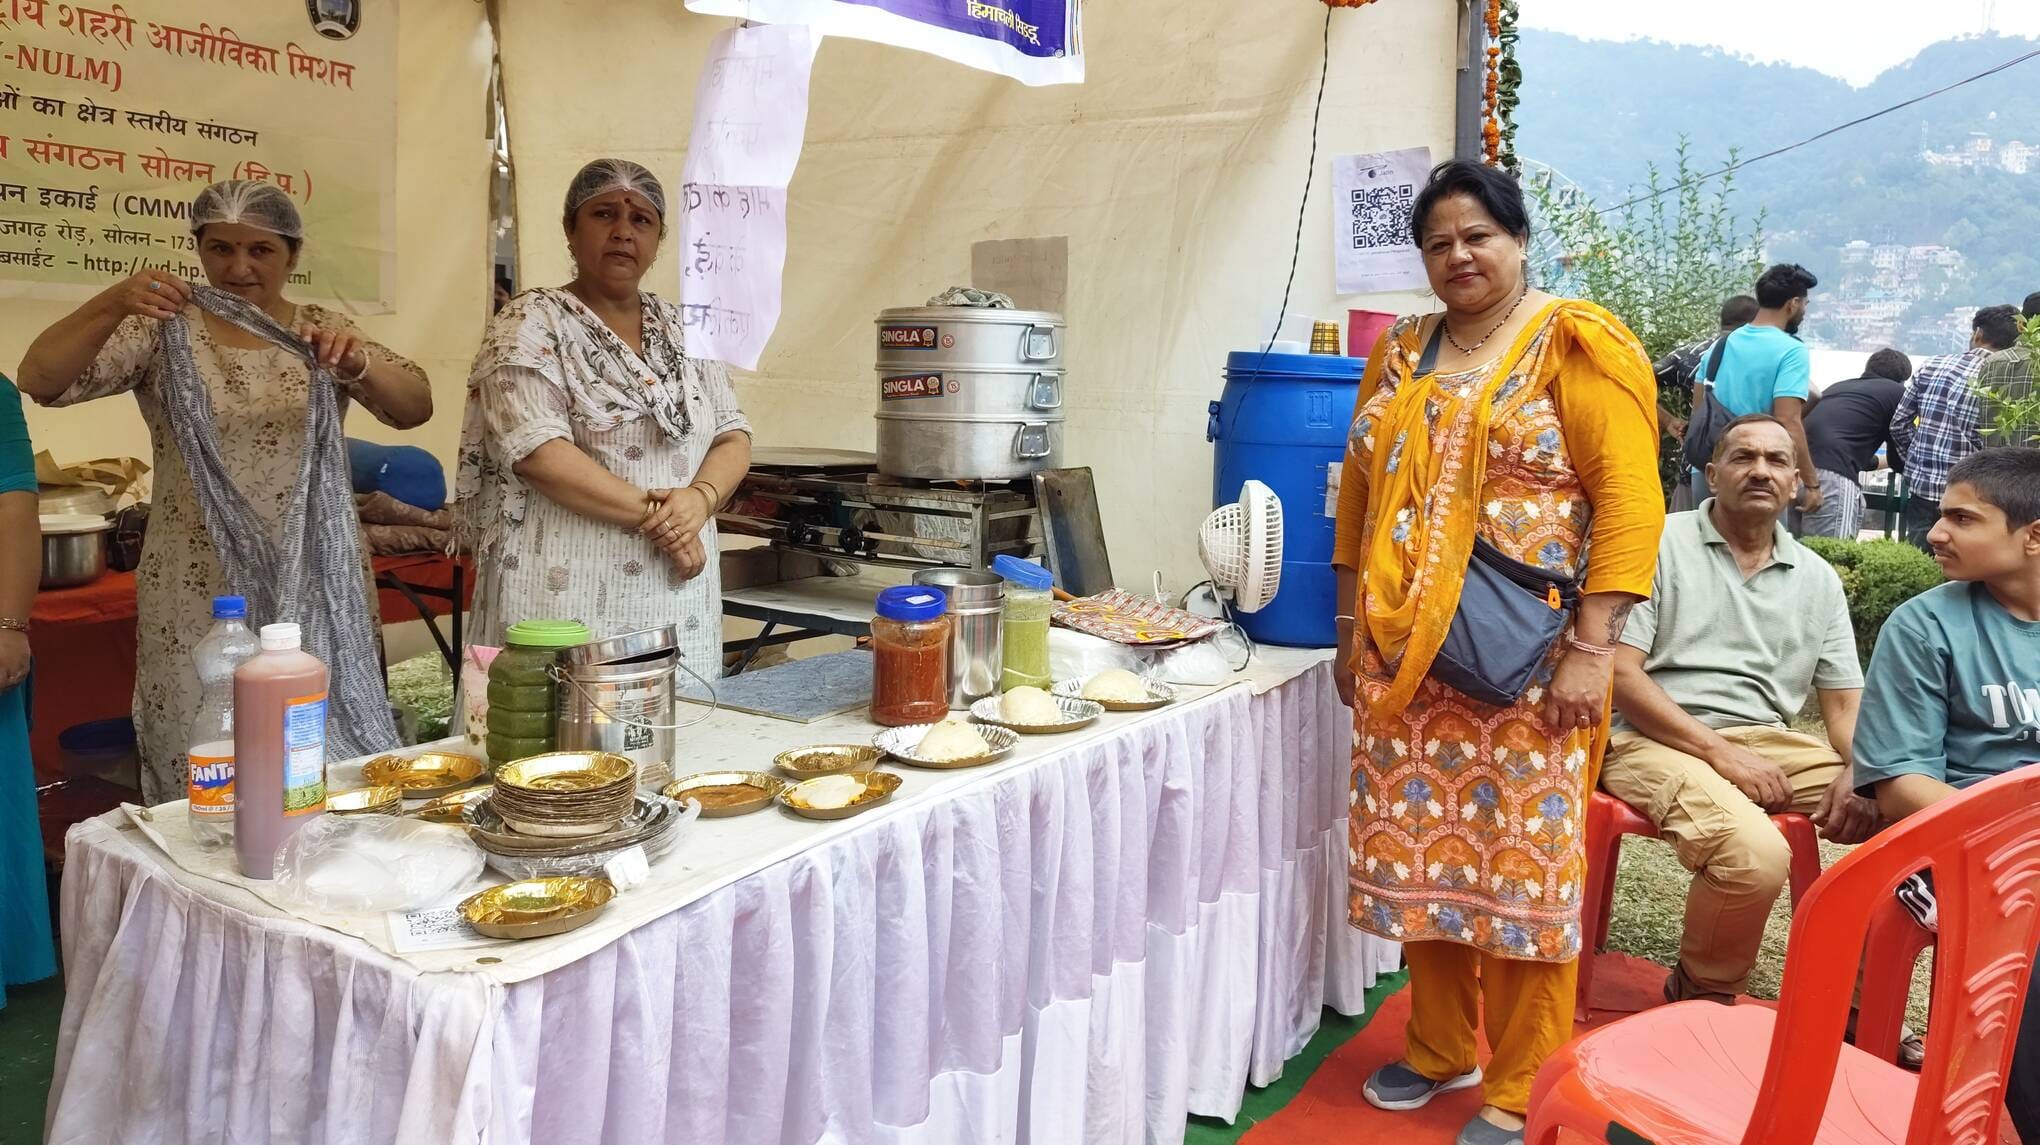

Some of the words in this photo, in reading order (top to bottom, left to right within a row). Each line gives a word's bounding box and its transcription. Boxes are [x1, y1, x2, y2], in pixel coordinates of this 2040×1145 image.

[0, 41, 122, 92] -NULM)
[58, 4, 138, 50] शहरी
[146, 22, 280, 75] आजीविका
[286, 42, 356, 90] मिशन
[31, 96, 66, 117] का
[77, 97, 117, 125] क्षेत्र
[126, 110, 187, 136] स्तरीय
[195, 118, 258, 146] संगठन
[23, 133, 126, 173] संगठन
[138, 147, 216, 184] सोलन
[37, 185, 99, 213] इकाई
[881, 330, 920, 343] SINGLA
[883, 379, 925, 394] SINGLA
